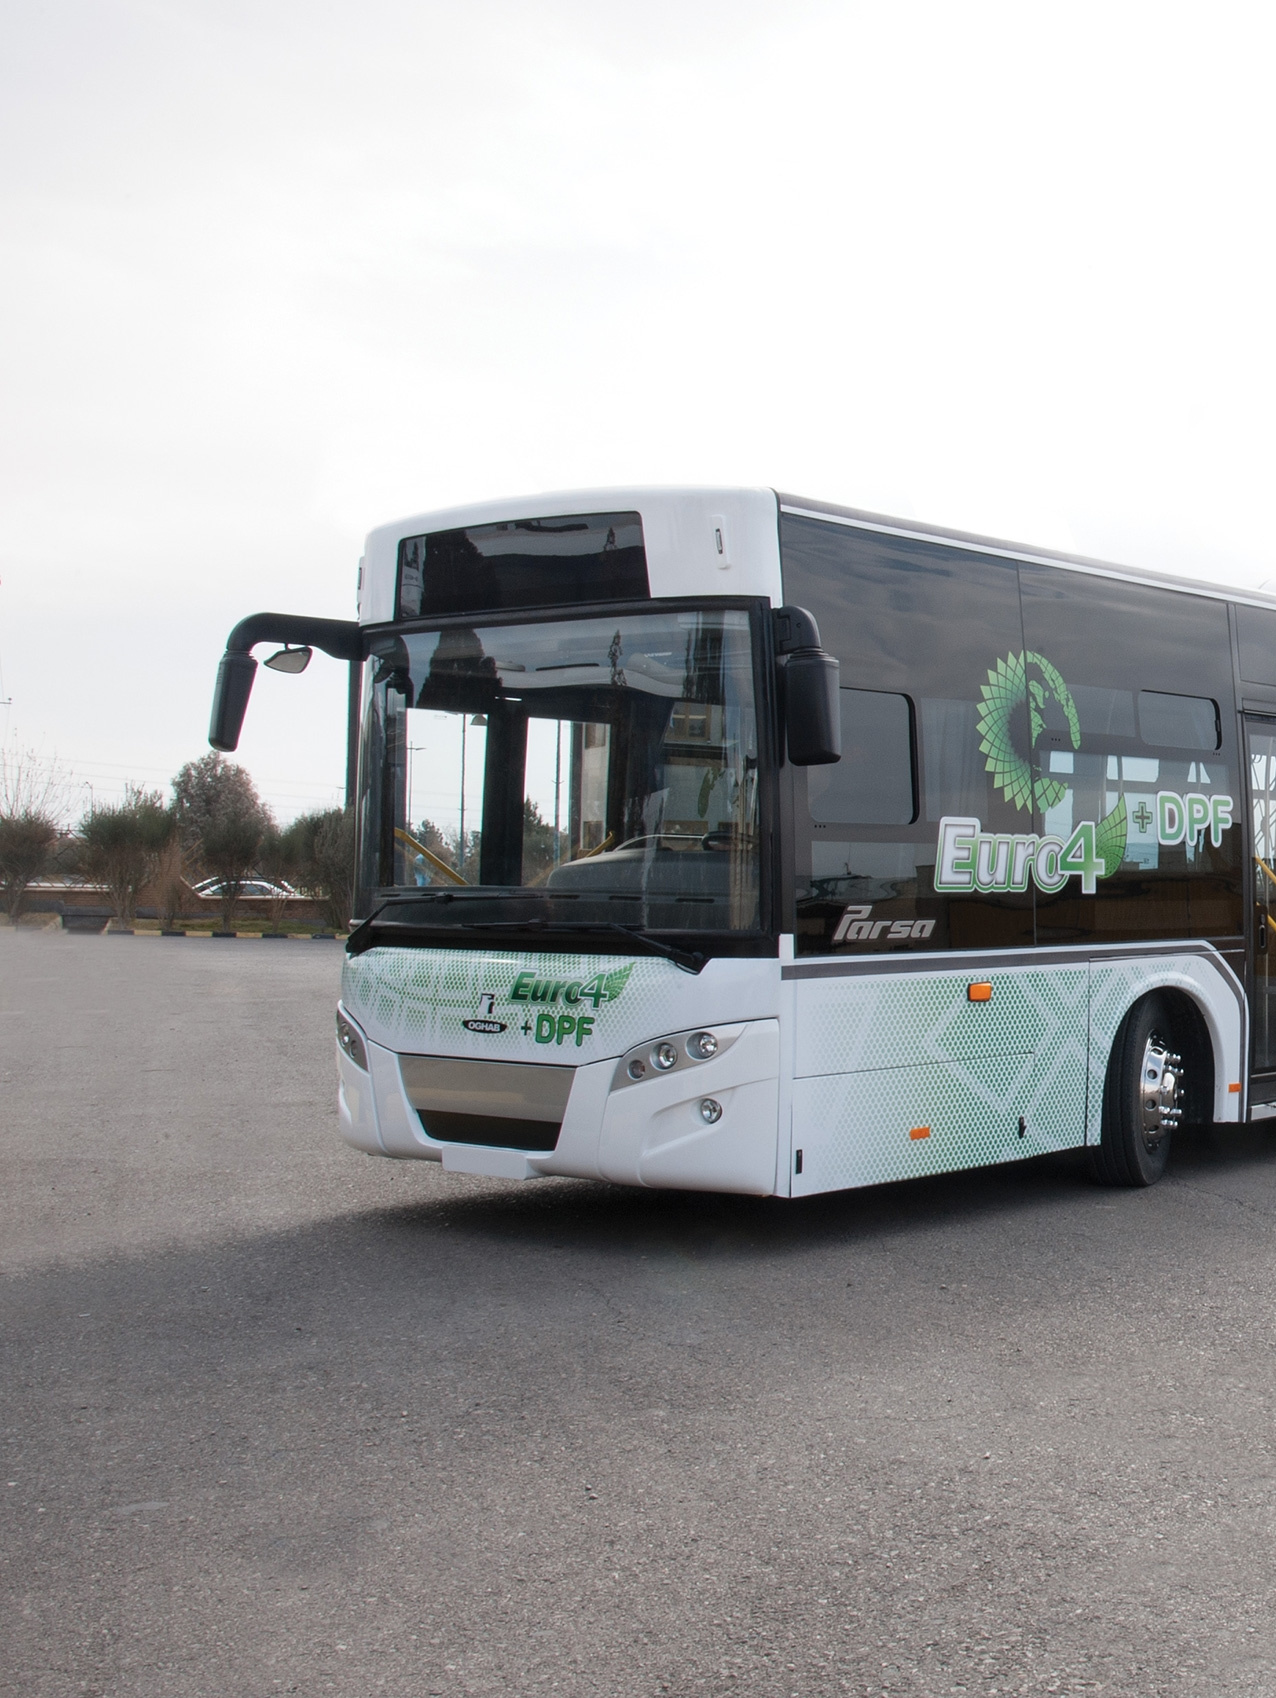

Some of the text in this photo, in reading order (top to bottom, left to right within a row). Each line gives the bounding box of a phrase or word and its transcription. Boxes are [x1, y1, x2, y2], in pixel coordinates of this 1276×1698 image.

[1157, 791, 1233, 847] DPF
[930, 815, 1105, 894] Euro4
[833, 905, 936, 940] Parsa
[510, 970, 609, 1010] Euro4
[468, 1022, 500, 1033] OGHAB
[535, 1013, 595, 1047] DPF
